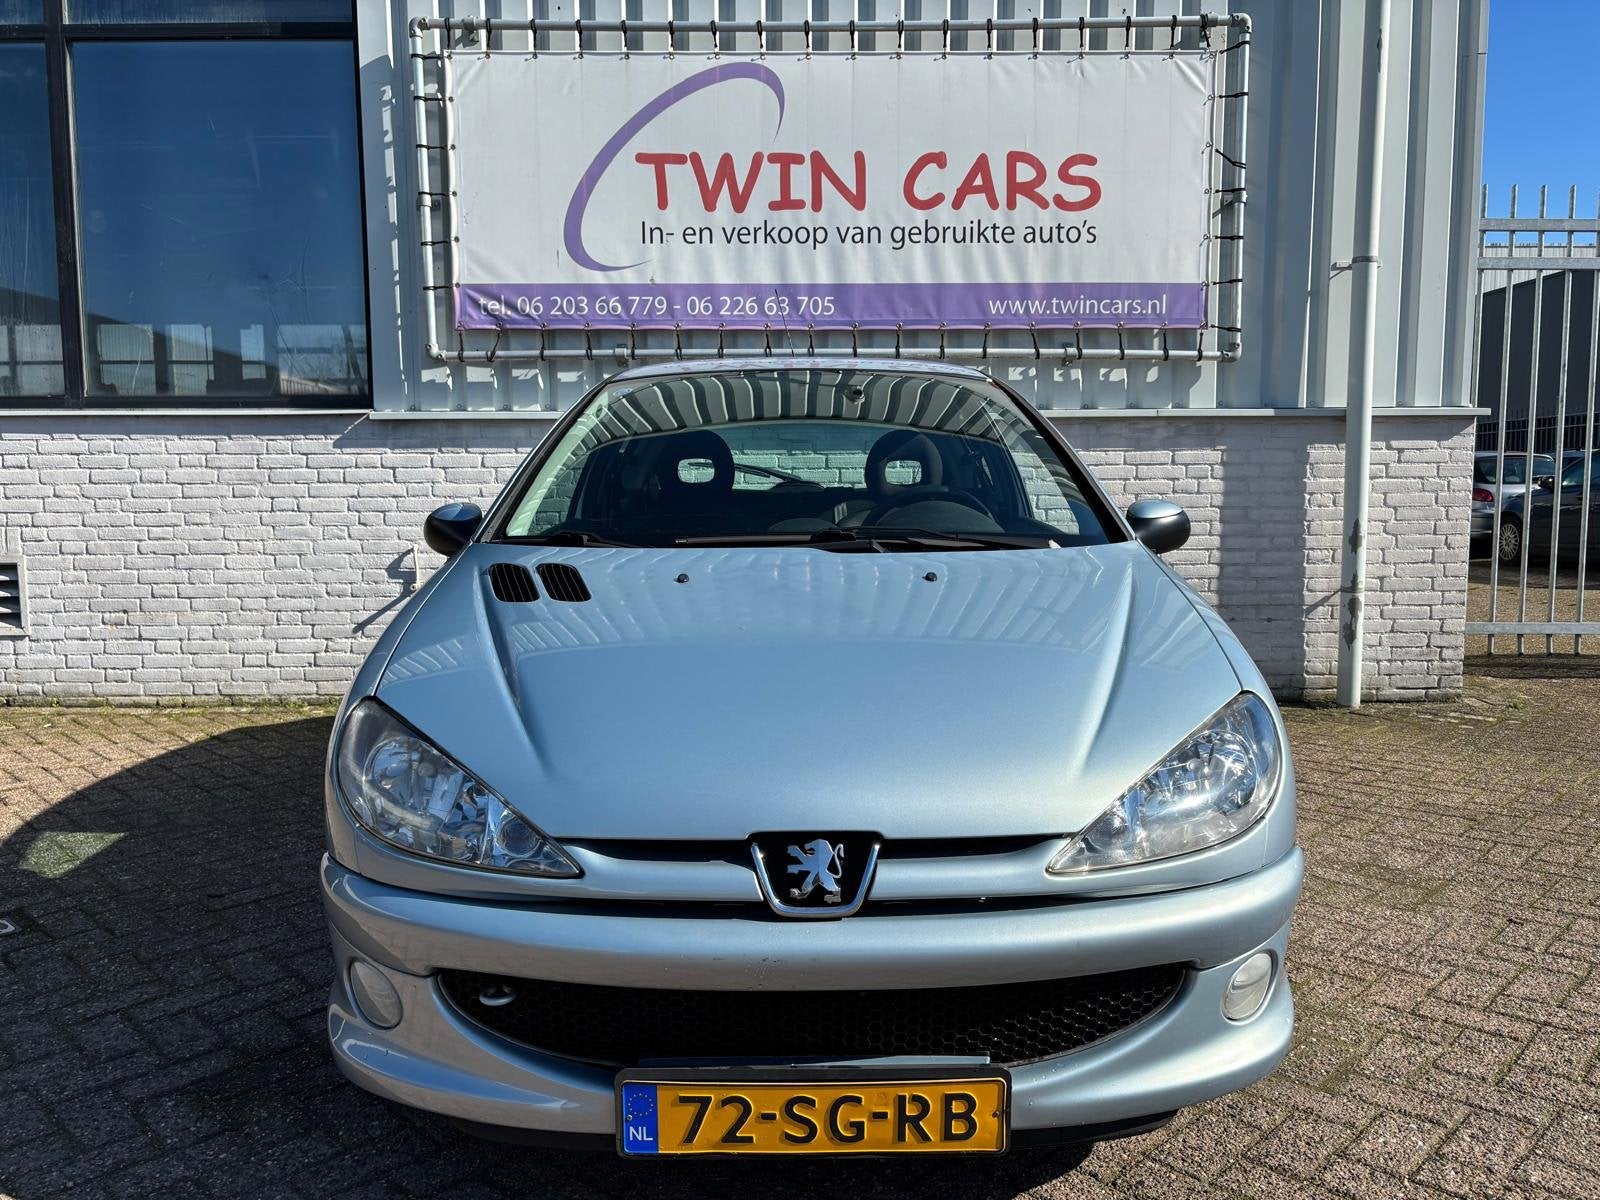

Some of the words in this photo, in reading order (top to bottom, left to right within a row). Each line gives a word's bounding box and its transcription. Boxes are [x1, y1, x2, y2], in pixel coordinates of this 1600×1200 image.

[635, 150, 867, 214] TWIN
[903, 150, 1102, 212] CARS
[641, 220, 674, 245] In-
[682, 226, 713, 244] en
[722, 219, 828, 250] verkoop
[836, 225, 882, 244] van
[890, 219, 1016, 250] gebruikte
[1023, 219, 1097, 244] auto's
[478, 295, 512, 316] tel.
[517, 296, 544, 315] 06
[550, 296, 589, 315] 203
[595, 296, 622, 315] 66
[628, 296, 667, 315] 779
[686, 296, 713, 315] 06
[719, 296, 758, 315] 226
[764, 296, 790, 315] 63
[797, 296, 835, 315] 705
[988, 293, 1167, 315] www.twincars.nl
[678, 1092, 979, 1145] 72-SG-RB
[629, 1126, 653, 1142] NL
